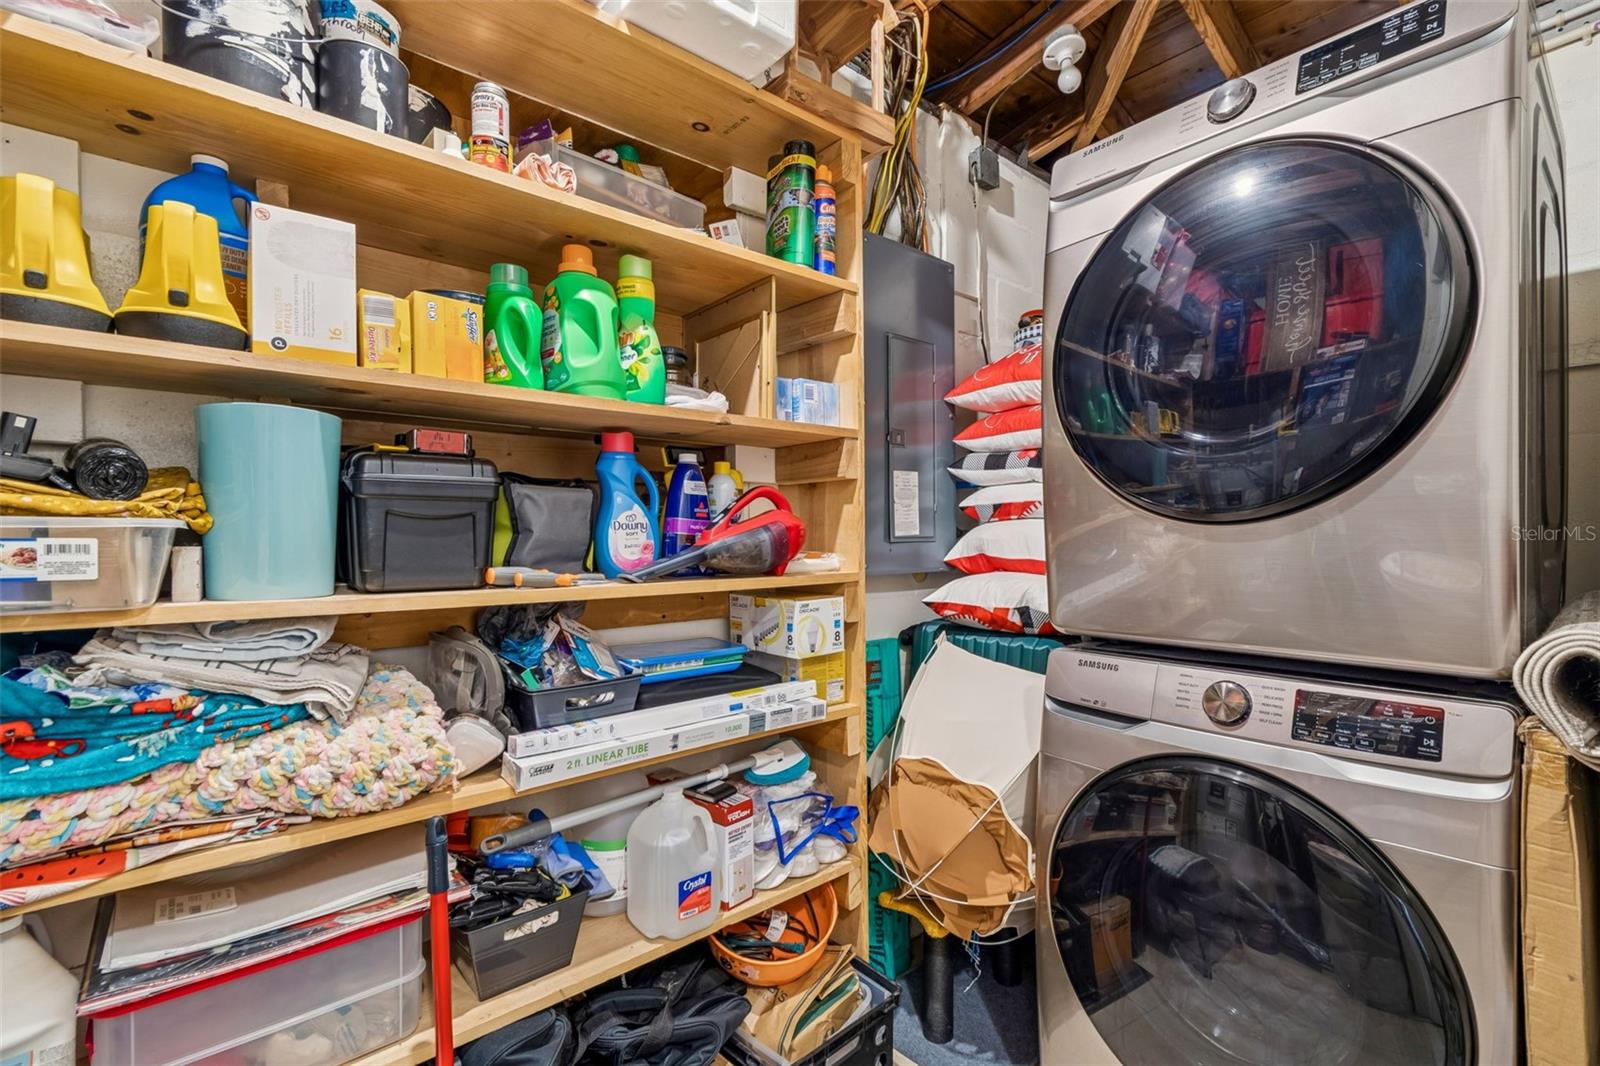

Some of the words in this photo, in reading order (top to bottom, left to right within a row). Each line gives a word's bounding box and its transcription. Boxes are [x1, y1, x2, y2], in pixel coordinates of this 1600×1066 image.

[1082, 133, 1125, 158] SAMSUNG
[466, 307, 478, 342] Swiffer
[329, 328, 342, 341] 16
[613, 520, 648, 534] Downy
[787, 634, 793, 646] 8
[834, 631, 841, 642] 8
[1077, 658, 1120, 672] SAMSUNG
[566, 760, 573, 770] 2
[574, 759, 584, 769] ft.
[586, 749, 624, 766] LINEAR
[626, 742, 649, 756] TUBE
[683, 874, 707, 892] Crystal
